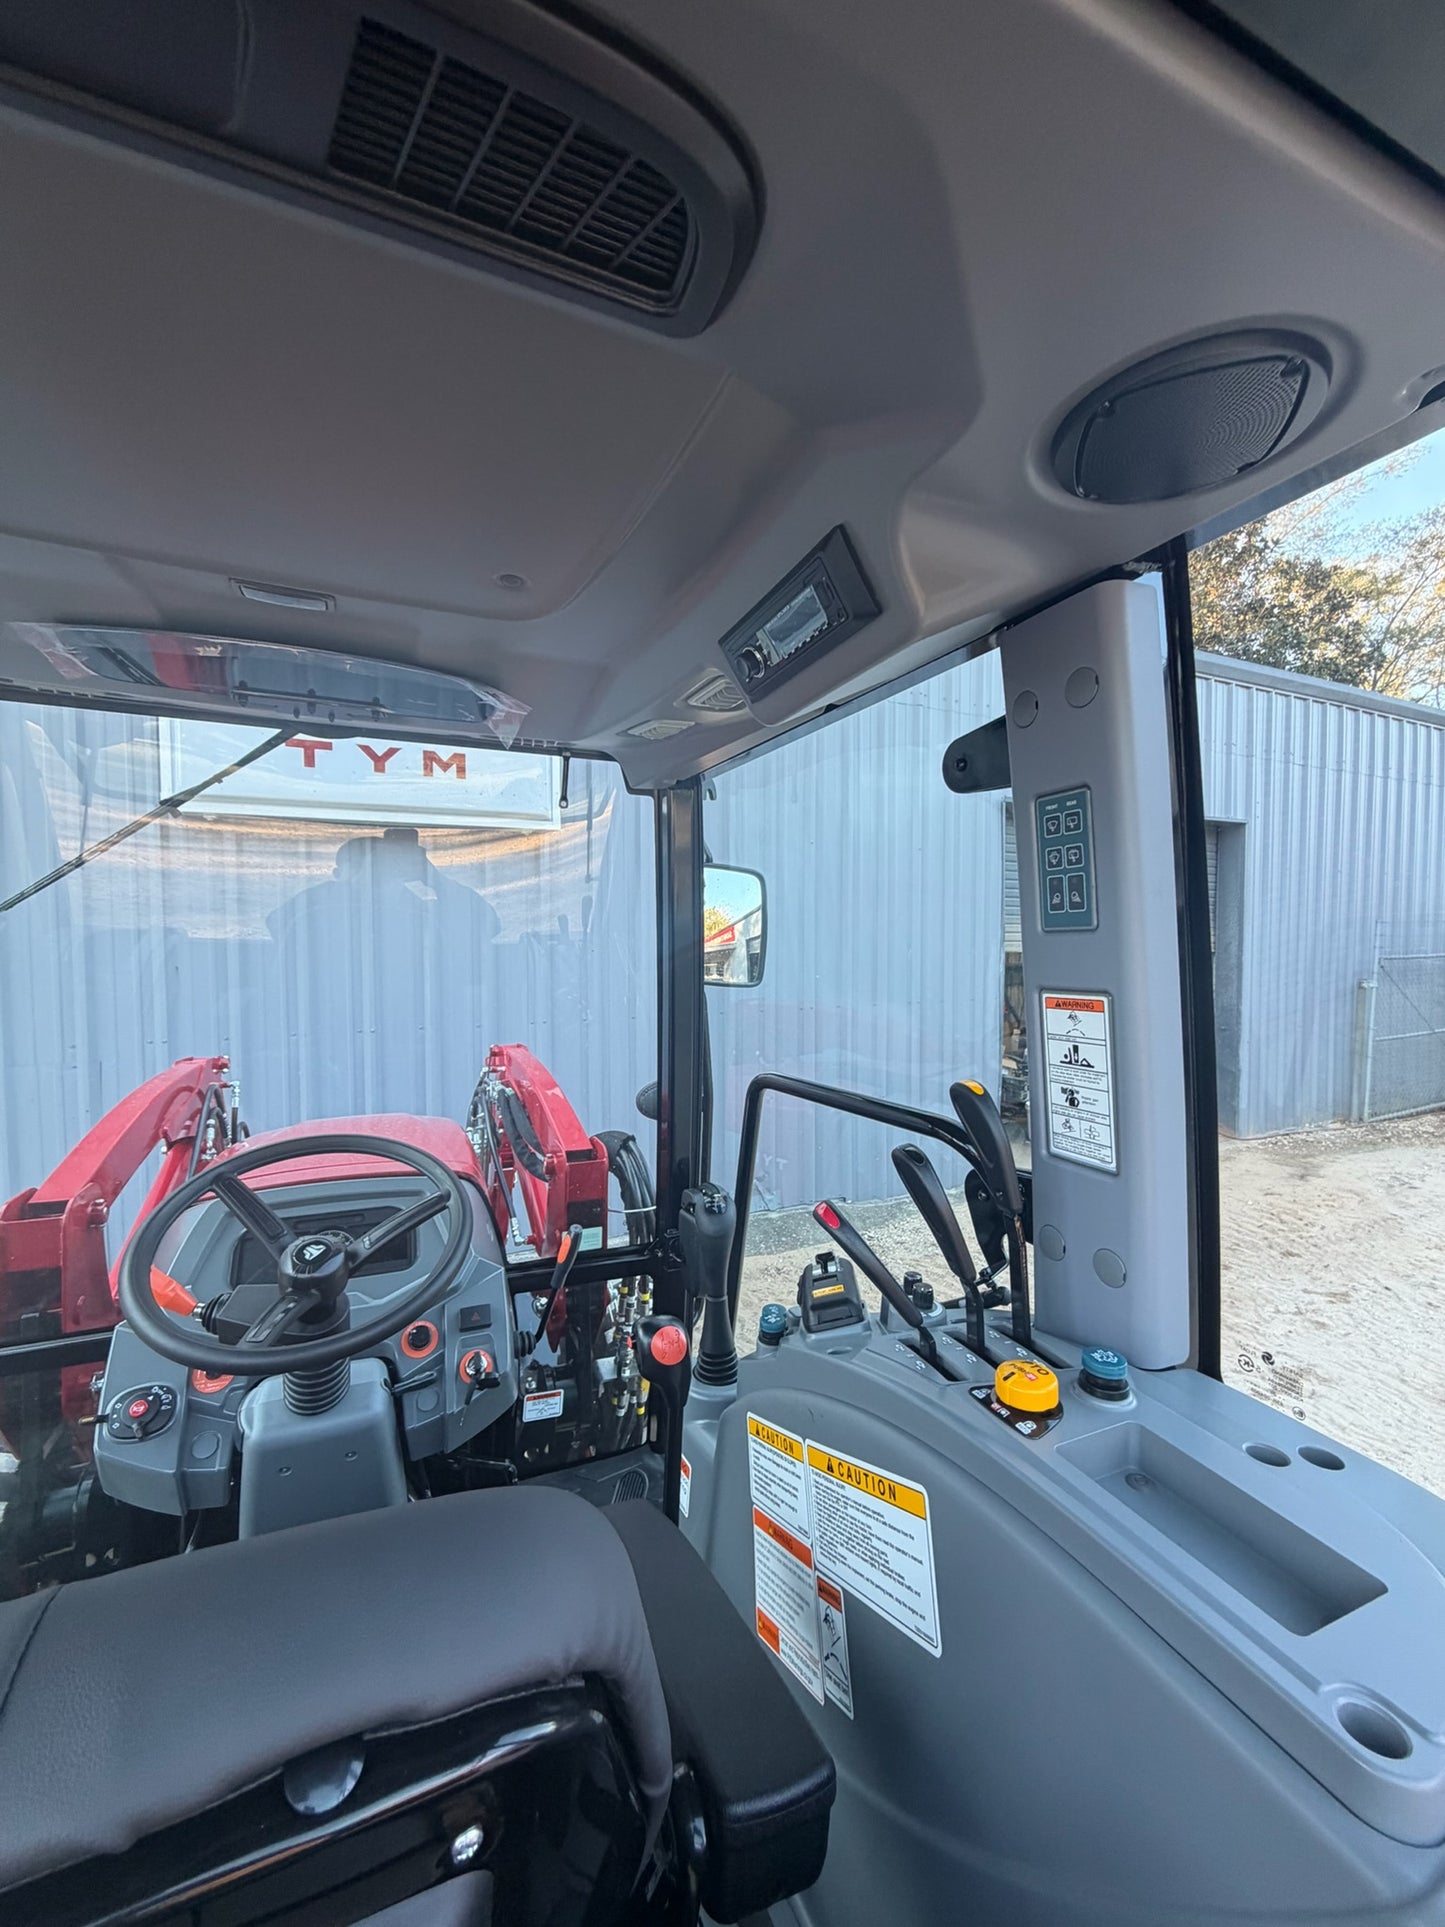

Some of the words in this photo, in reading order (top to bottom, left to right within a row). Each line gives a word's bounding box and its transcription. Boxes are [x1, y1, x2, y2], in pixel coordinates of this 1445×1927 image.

[285, 738, 467, 779] TYM
[1060, 1000, 1095, 1009] WARNING
[761, 1425, 795, 1456] CAUTION
[838, 1462, 897, 1502] CAUTION
